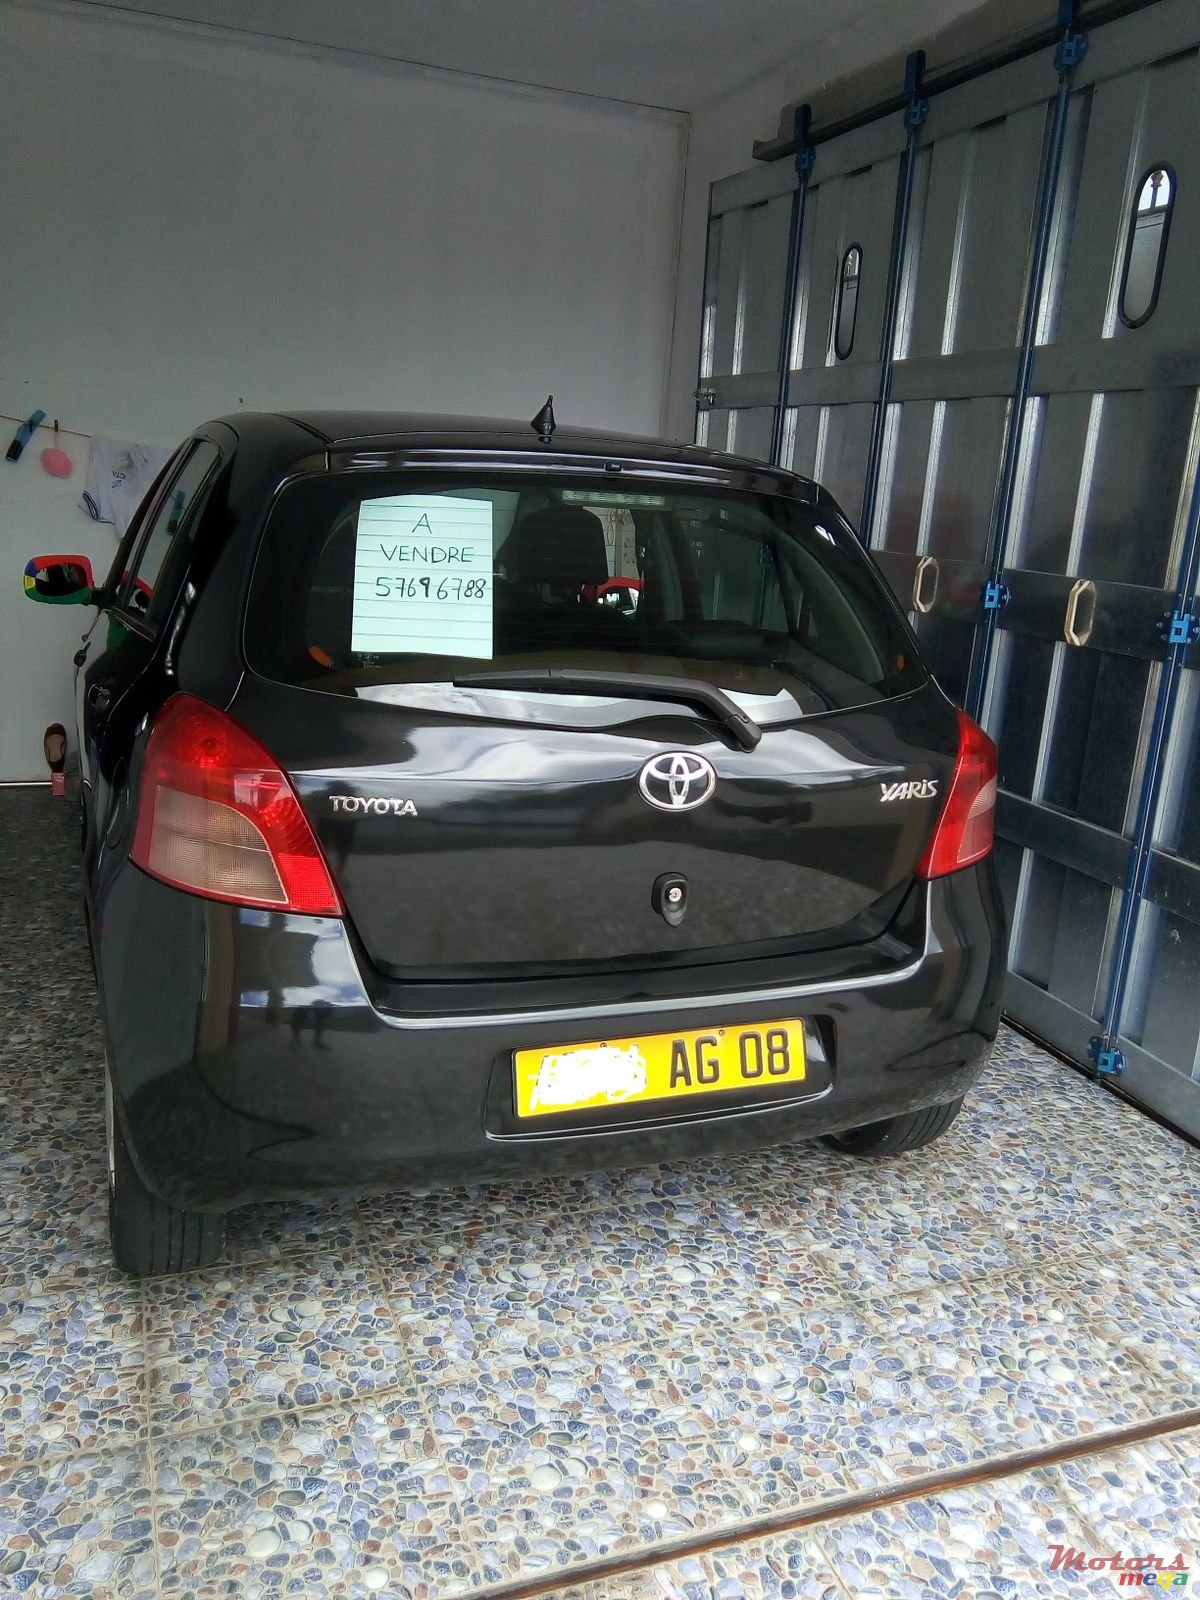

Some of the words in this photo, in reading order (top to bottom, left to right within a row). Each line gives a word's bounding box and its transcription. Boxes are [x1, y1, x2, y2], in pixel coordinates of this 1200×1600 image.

[411, 512, 432, 534] A
[380, 543, 474, 564] VENDRE
[328, 795, 418, 817] TOYOTA
[669, 1035, 720, 1089] AG
[738, 1027, 791, 1079] 08
